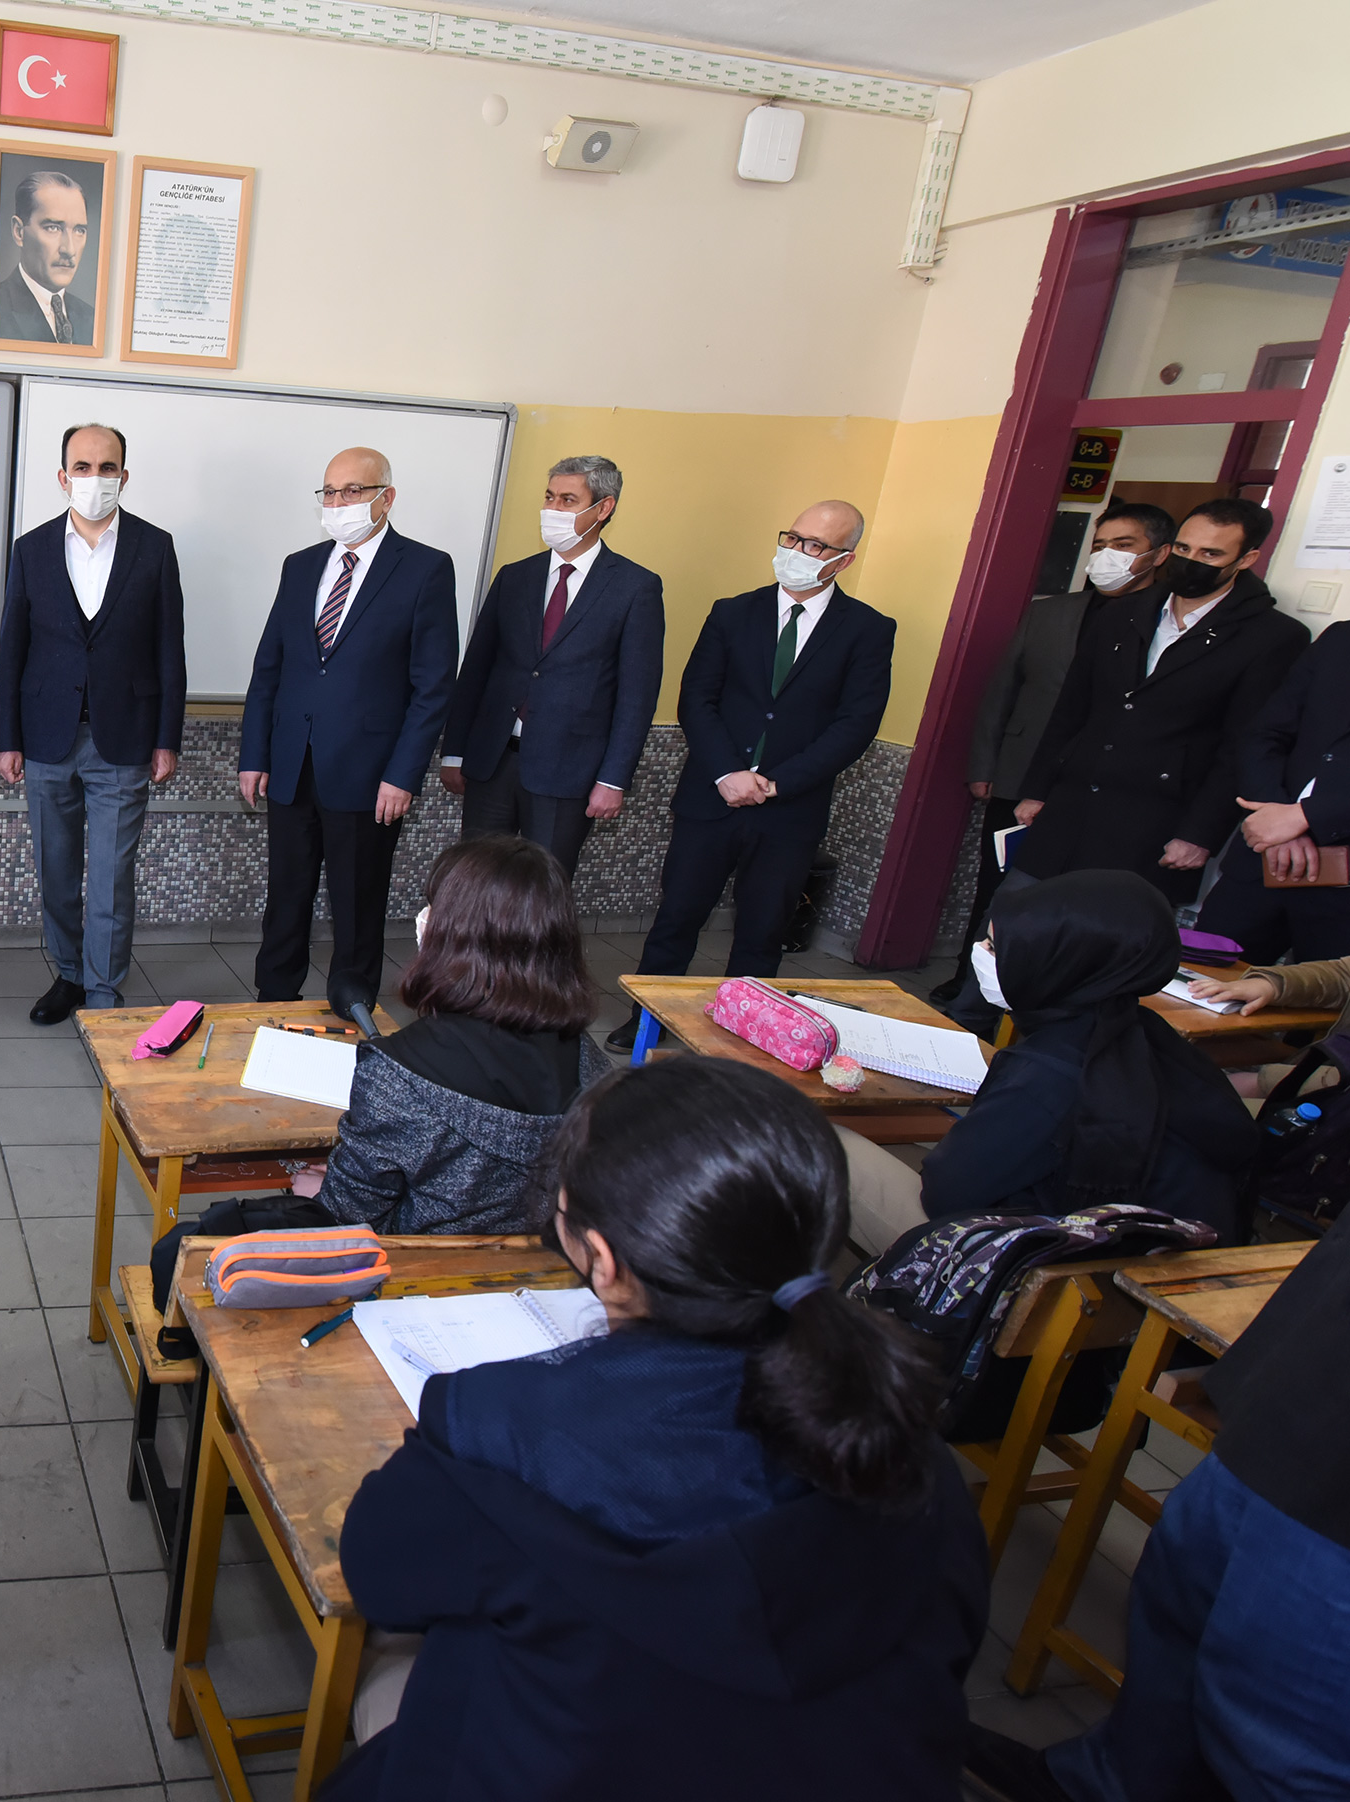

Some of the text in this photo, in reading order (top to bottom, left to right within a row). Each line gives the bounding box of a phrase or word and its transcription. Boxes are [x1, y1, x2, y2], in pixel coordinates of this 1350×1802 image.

[160, 190, 226, 203] GENÇLİĞE HİTABESİ
[1079, 441, 1103, 456] 8-B
[1070, 473, 1094, 488] 5-B
